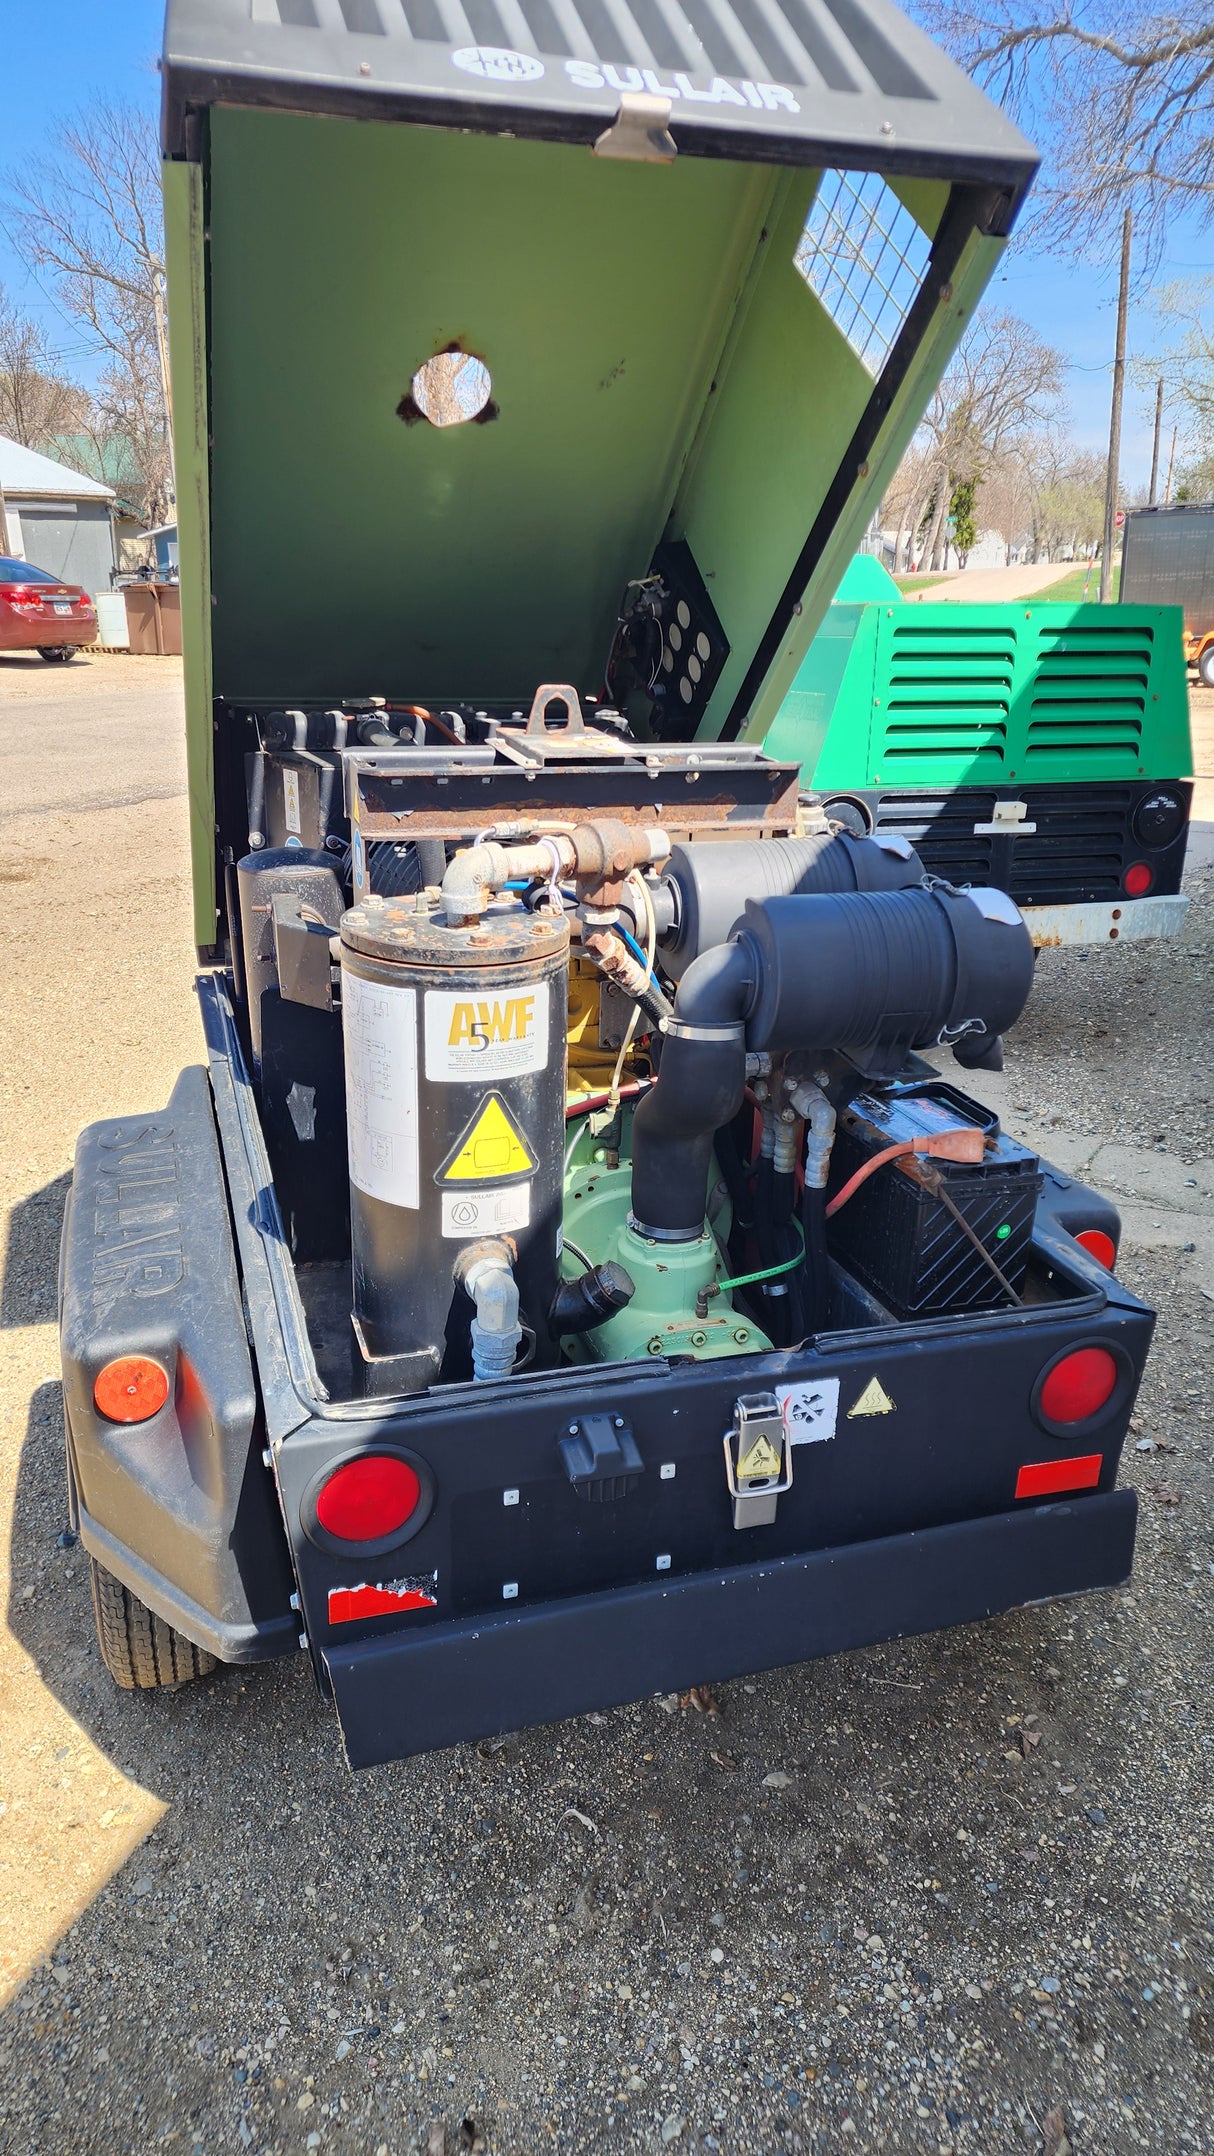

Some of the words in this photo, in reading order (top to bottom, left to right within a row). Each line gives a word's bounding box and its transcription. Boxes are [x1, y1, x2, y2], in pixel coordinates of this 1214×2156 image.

[563, 59, 801, 113] SULLAIR
[448, 996, 534, 1045] AWF
[471, 1022, 489, 1052] 5
[93, 1125, 185, 1307] SULLAIR
